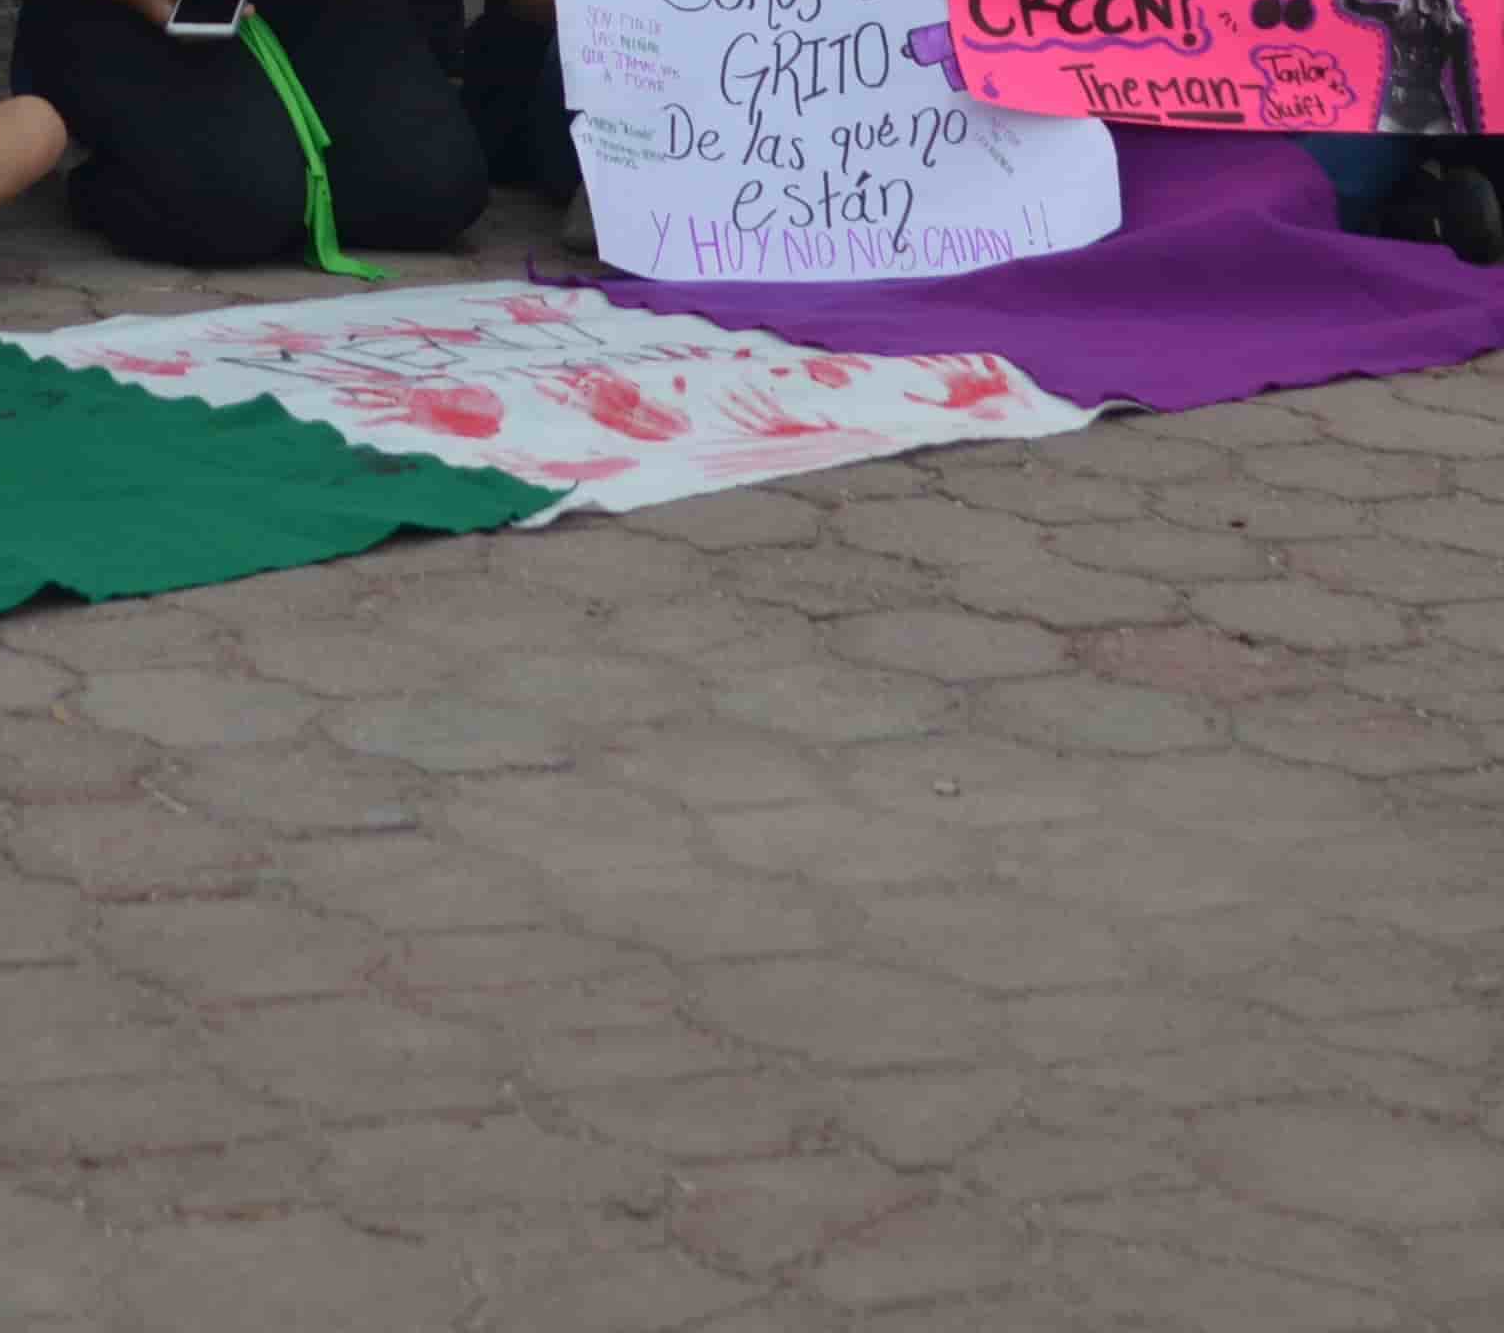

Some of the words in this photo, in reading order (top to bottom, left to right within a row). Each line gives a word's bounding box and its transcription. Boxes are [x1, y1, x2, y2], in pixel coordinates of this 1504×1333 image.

[720, 22, 890, 125] GRITO
[663, 103, 726, 161] De
[742, 111, 804, 169] las
[897, 108, 968, 167] no
[651, 212, 671, 274] Y
[691, 216, 772, 276] HOY
[782, 228, 835, 271] NO
[847, 225, 916, 273] NOS
[733, 171, 914, 253] están
